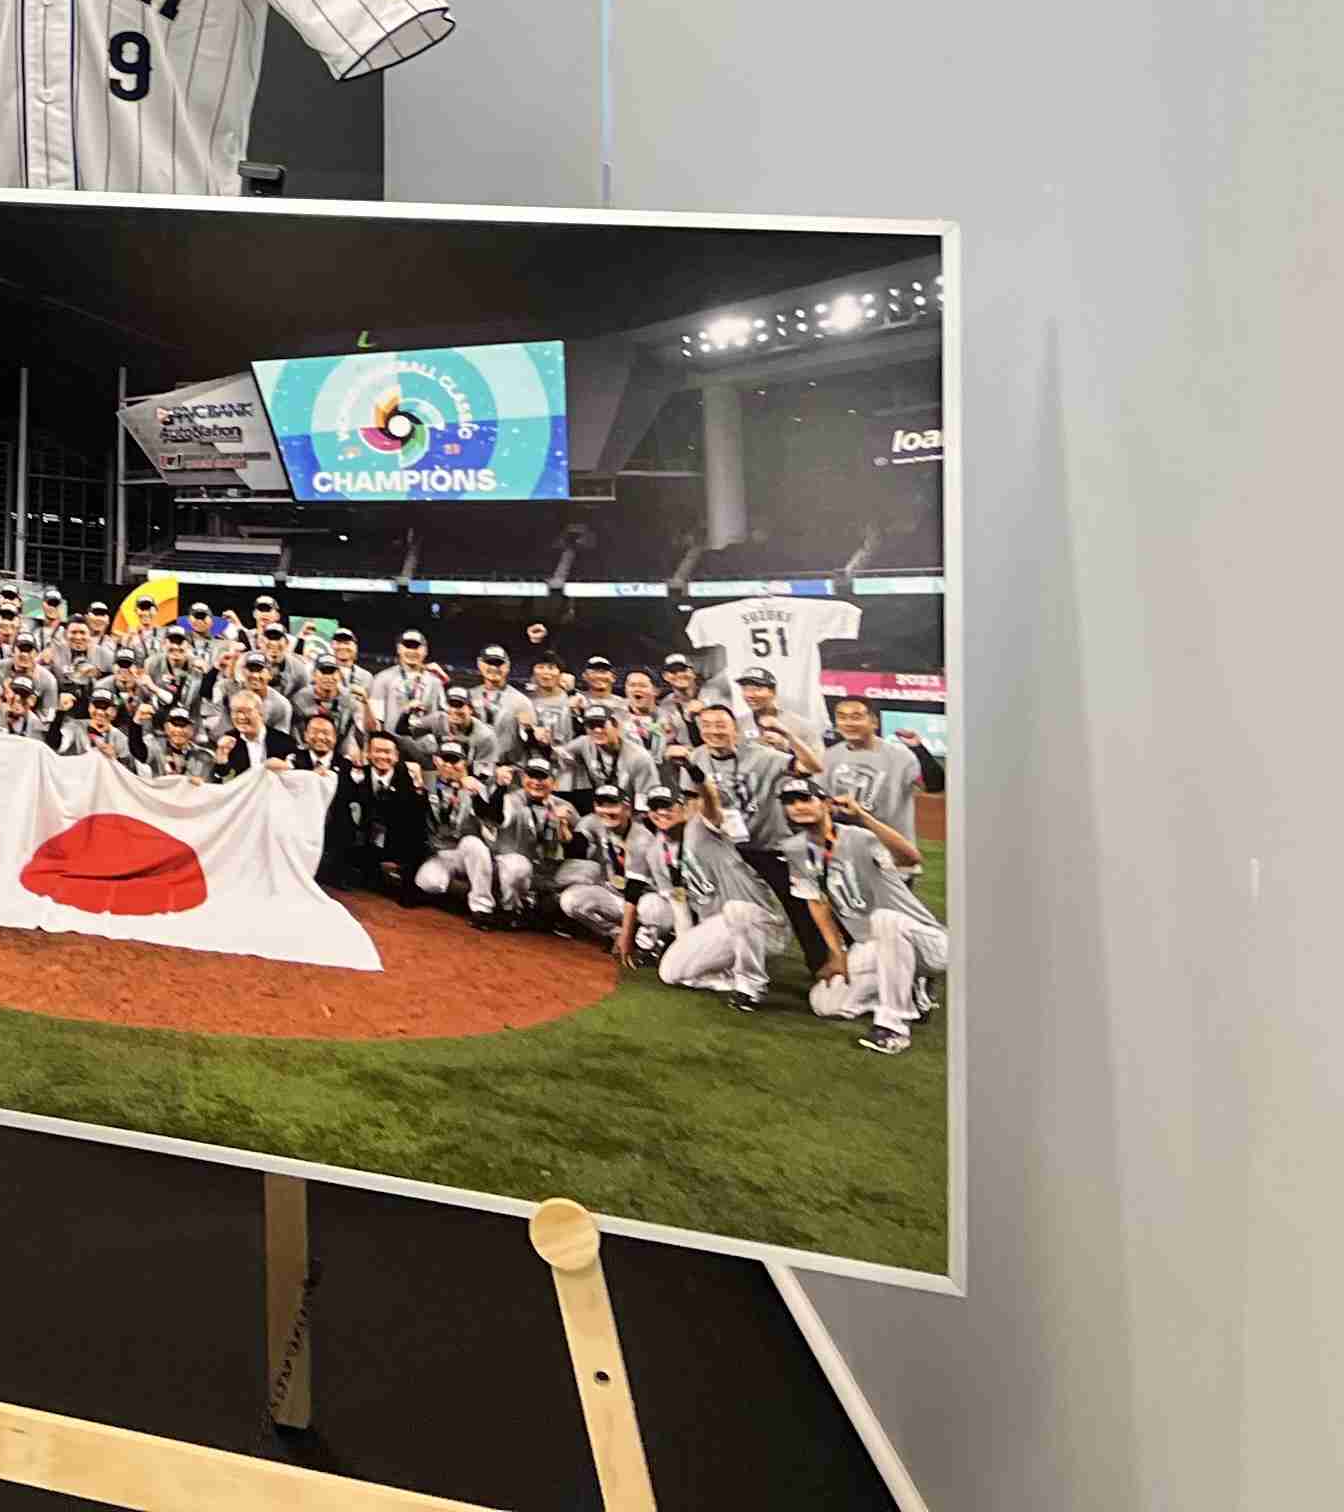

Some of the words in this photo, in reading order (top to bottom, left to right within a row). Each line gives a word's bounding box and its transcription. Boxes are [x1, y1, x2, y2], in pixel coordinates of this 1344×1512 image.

[108, 31, 152, 101] 9
[312, 468, 497, 494] CHAMPIONS
[750, 626, 790, 657] 51
